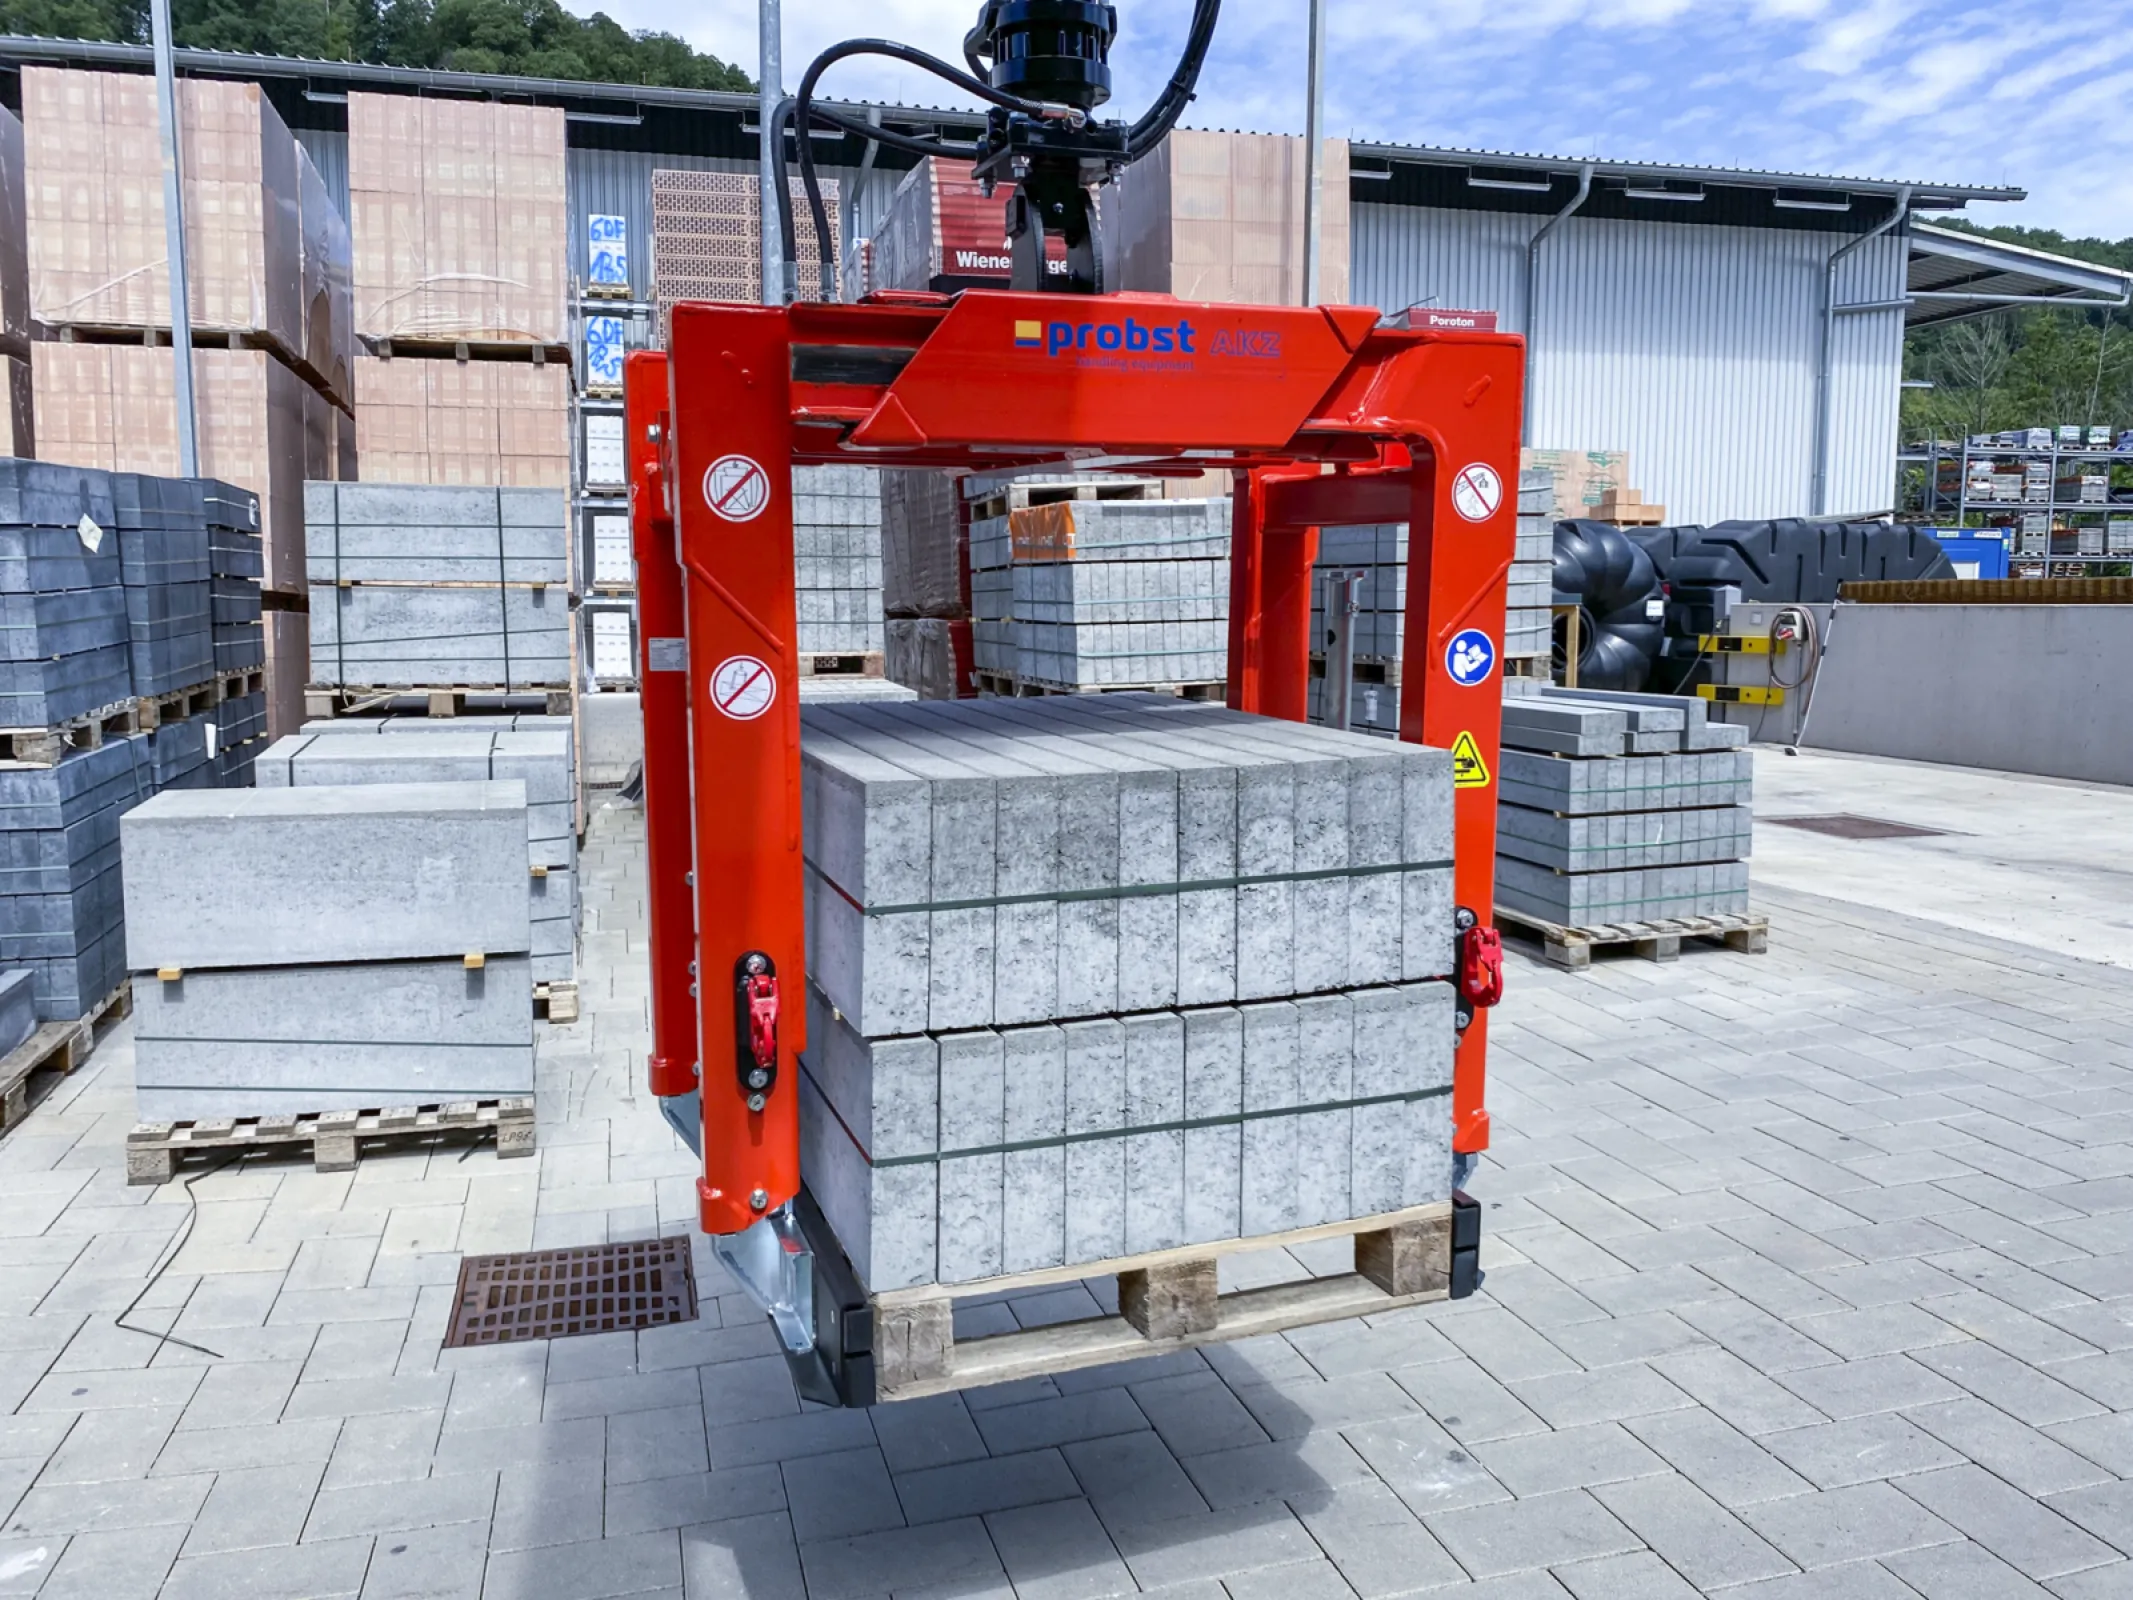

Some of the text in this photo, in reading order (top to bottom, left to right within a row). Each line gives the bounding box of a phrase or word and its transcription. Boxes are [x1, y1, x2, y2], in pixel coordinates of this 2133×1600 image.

[1430, 315, 1475, 327] Poroton
[1048, 318, 1281, 358] probst AKZ
